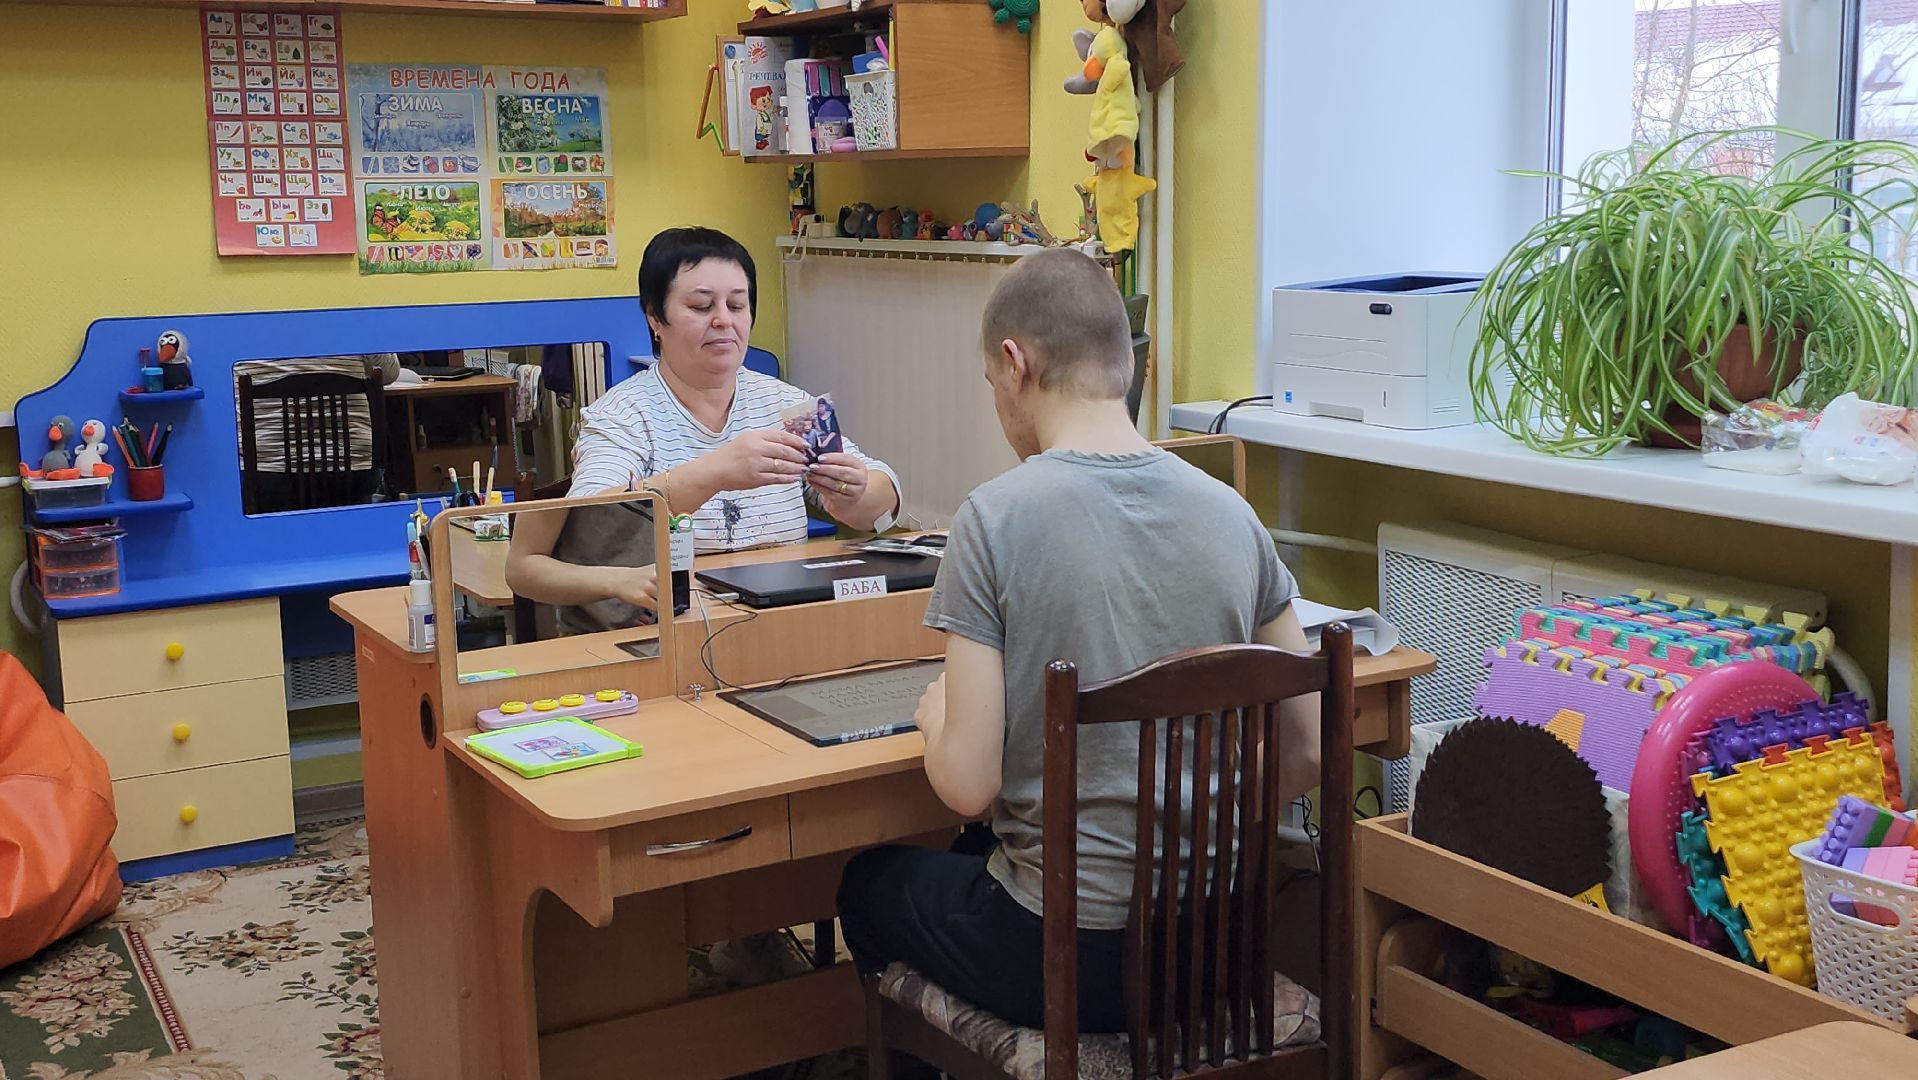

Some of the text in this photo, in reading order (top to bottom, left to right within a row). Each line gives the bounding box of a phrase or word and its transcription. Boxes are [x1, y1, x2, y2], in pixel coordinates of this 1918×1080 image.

[390, 68, 571, 93] ВРЕМЕНА ГОДА
[389, 96, 443, 111] ЗИМА
[522, 98, 583, 114] ВЕСНА
[400, 185, 450, 200] ЛЕТО
[526, 185, 587, 200] ОСЕНЬ
[840, 580, 882, 597] БАБА
